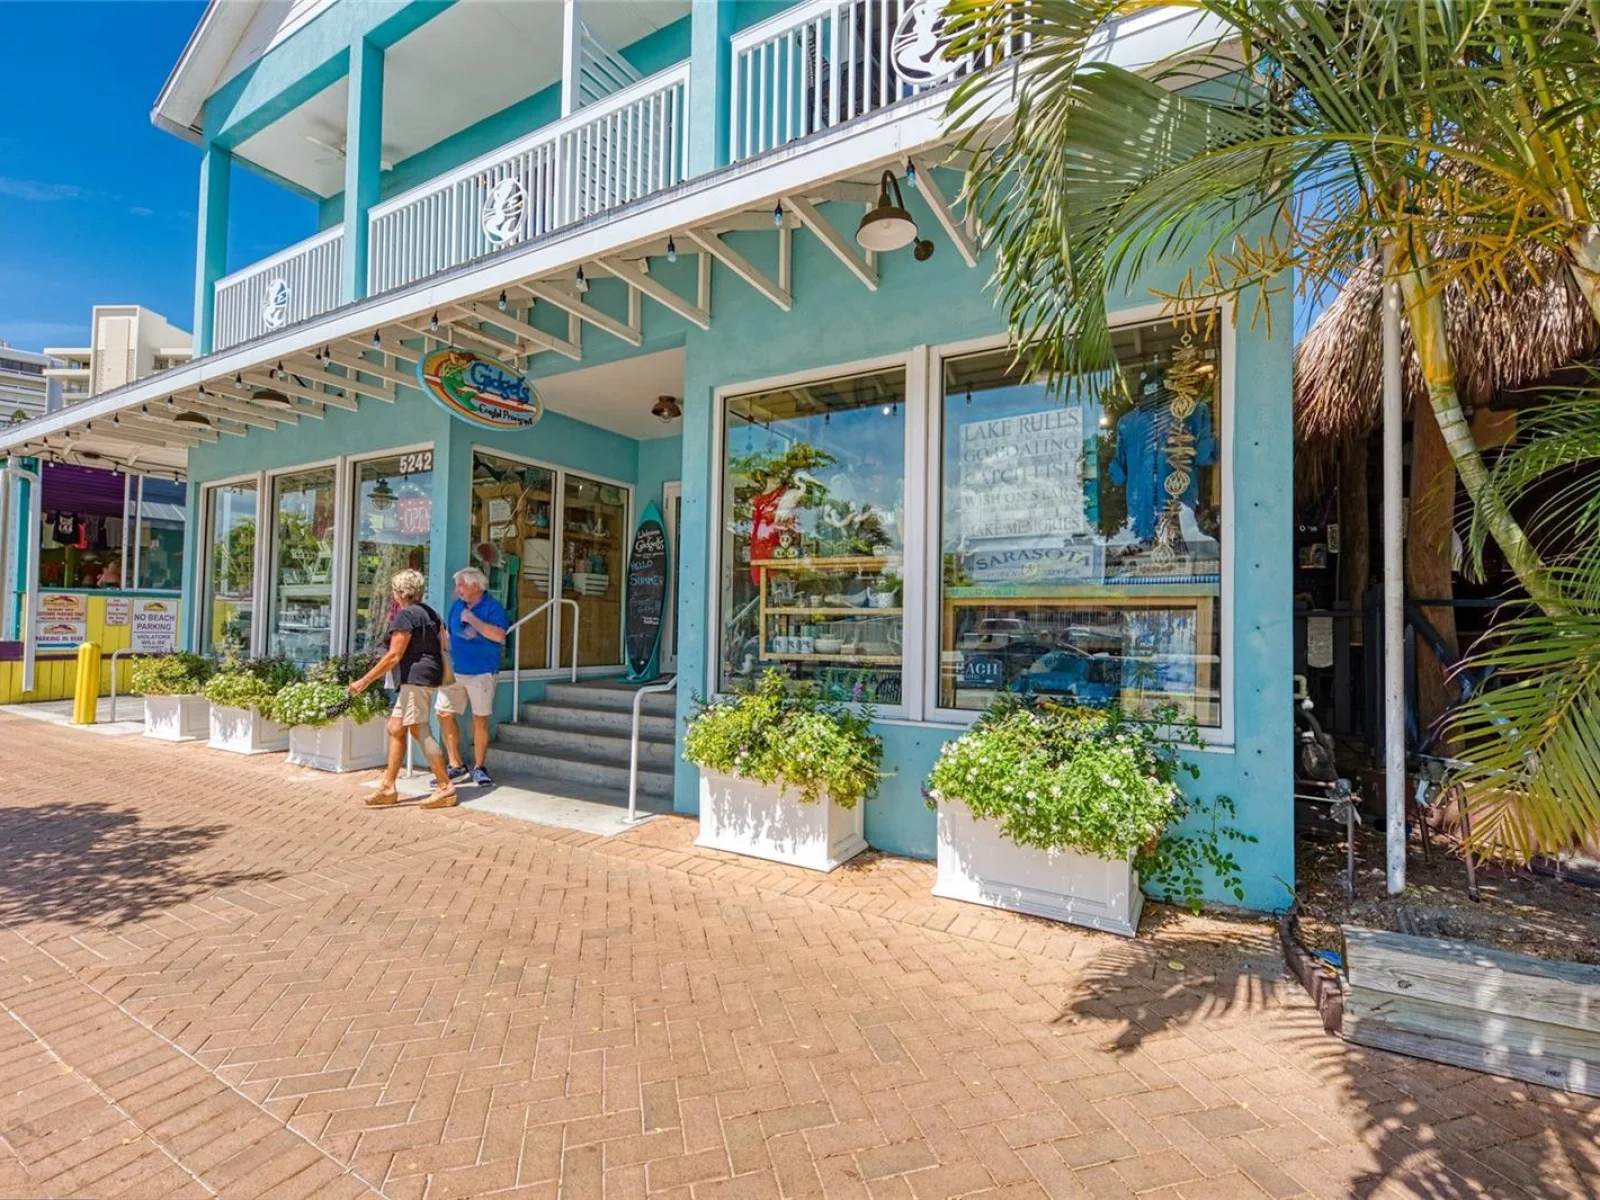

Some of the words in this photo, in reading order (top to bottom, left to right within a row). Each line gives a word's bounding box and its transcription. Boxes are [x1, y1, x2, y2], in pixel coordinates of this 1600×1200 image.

[964, 420, 1012, 442] LAKE
[1019, 409, 1079, 435] RULES
[963, 447, 990, 462] GO
[994, 436, 1079, 459] BOATING
[400, 453, 431, 473] 5242
[1007, 518, 1080, 535] MEMORIES
[976, 548, 1090, 571] SARASOTA
[133, 613, 147, 621] NO
[148, 613, 175, 622] BEACH
[136, 622, 172, 631] PARKING
